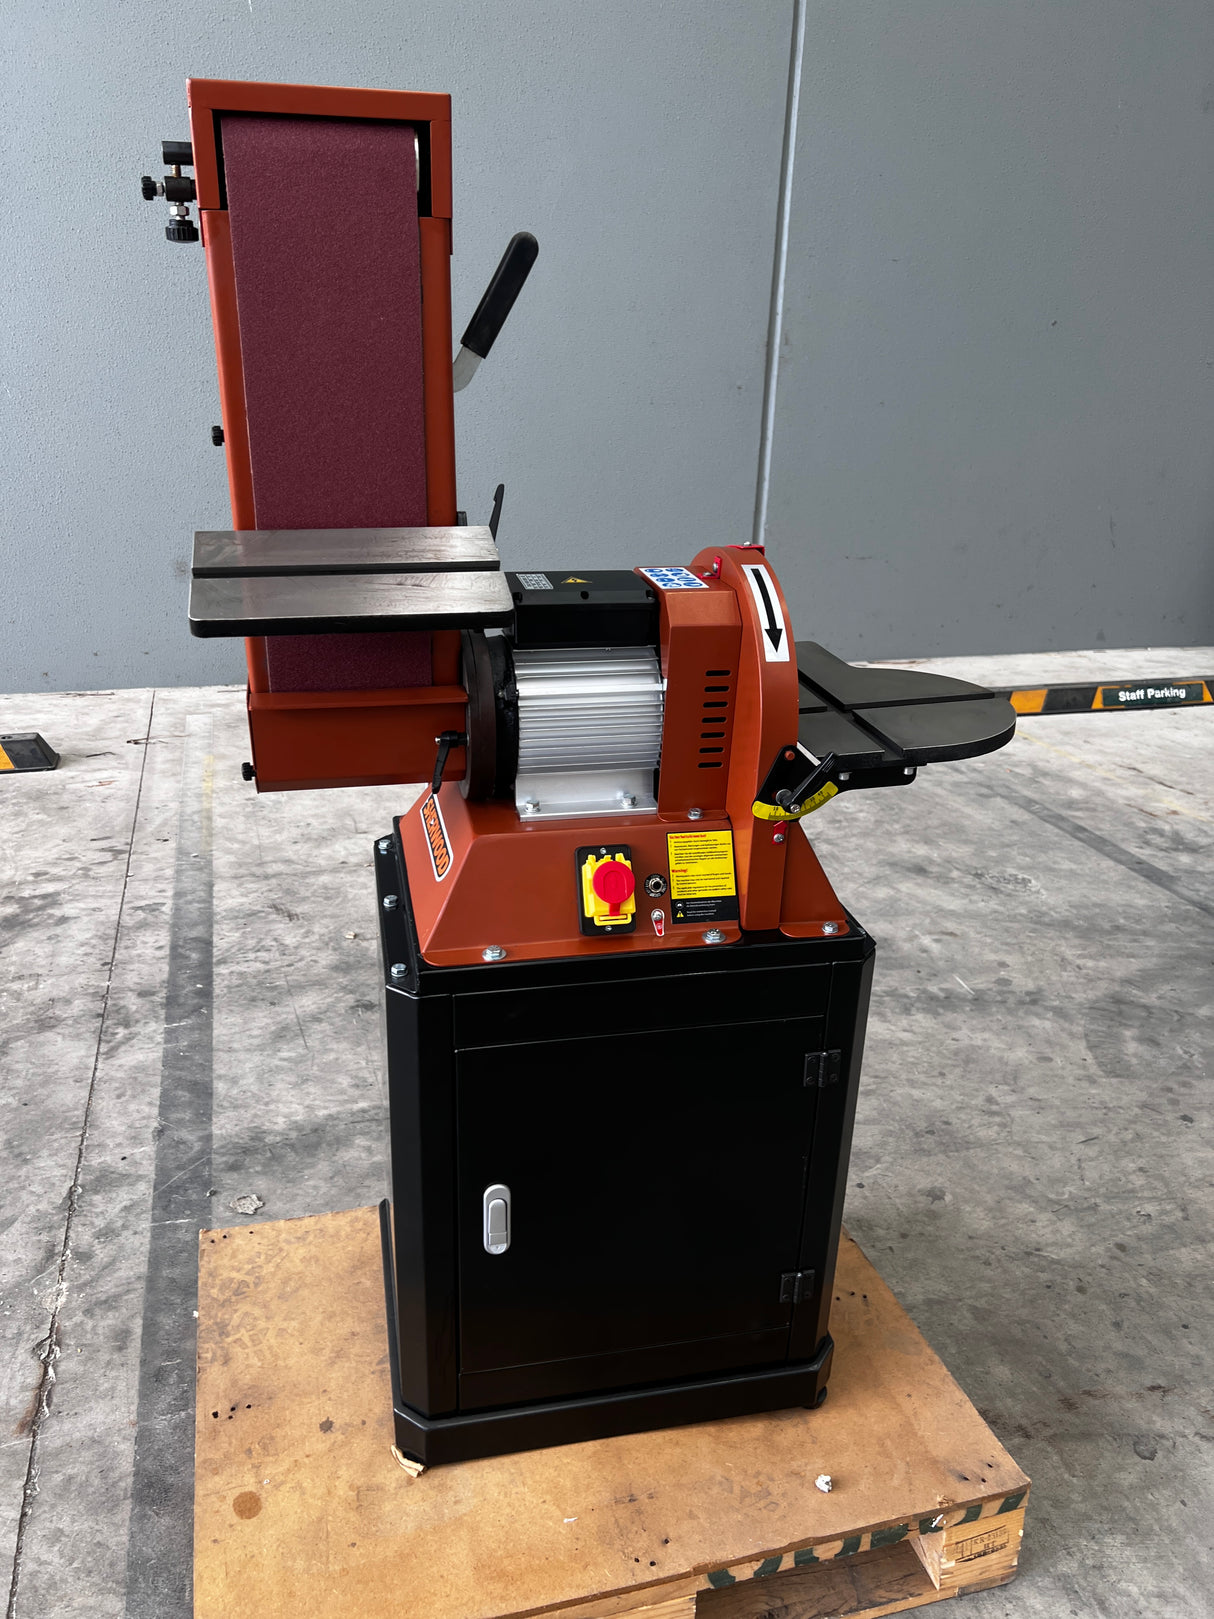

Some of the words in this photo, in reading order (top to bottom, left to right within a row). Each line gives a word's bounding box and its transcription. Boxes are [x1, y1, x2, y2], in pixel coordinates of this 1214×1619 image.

[1118, 690, 1145, 702] Staff
[1147, 687, 1186, 699] Parking
[423, 798, 450, 876] SHERWOOD
